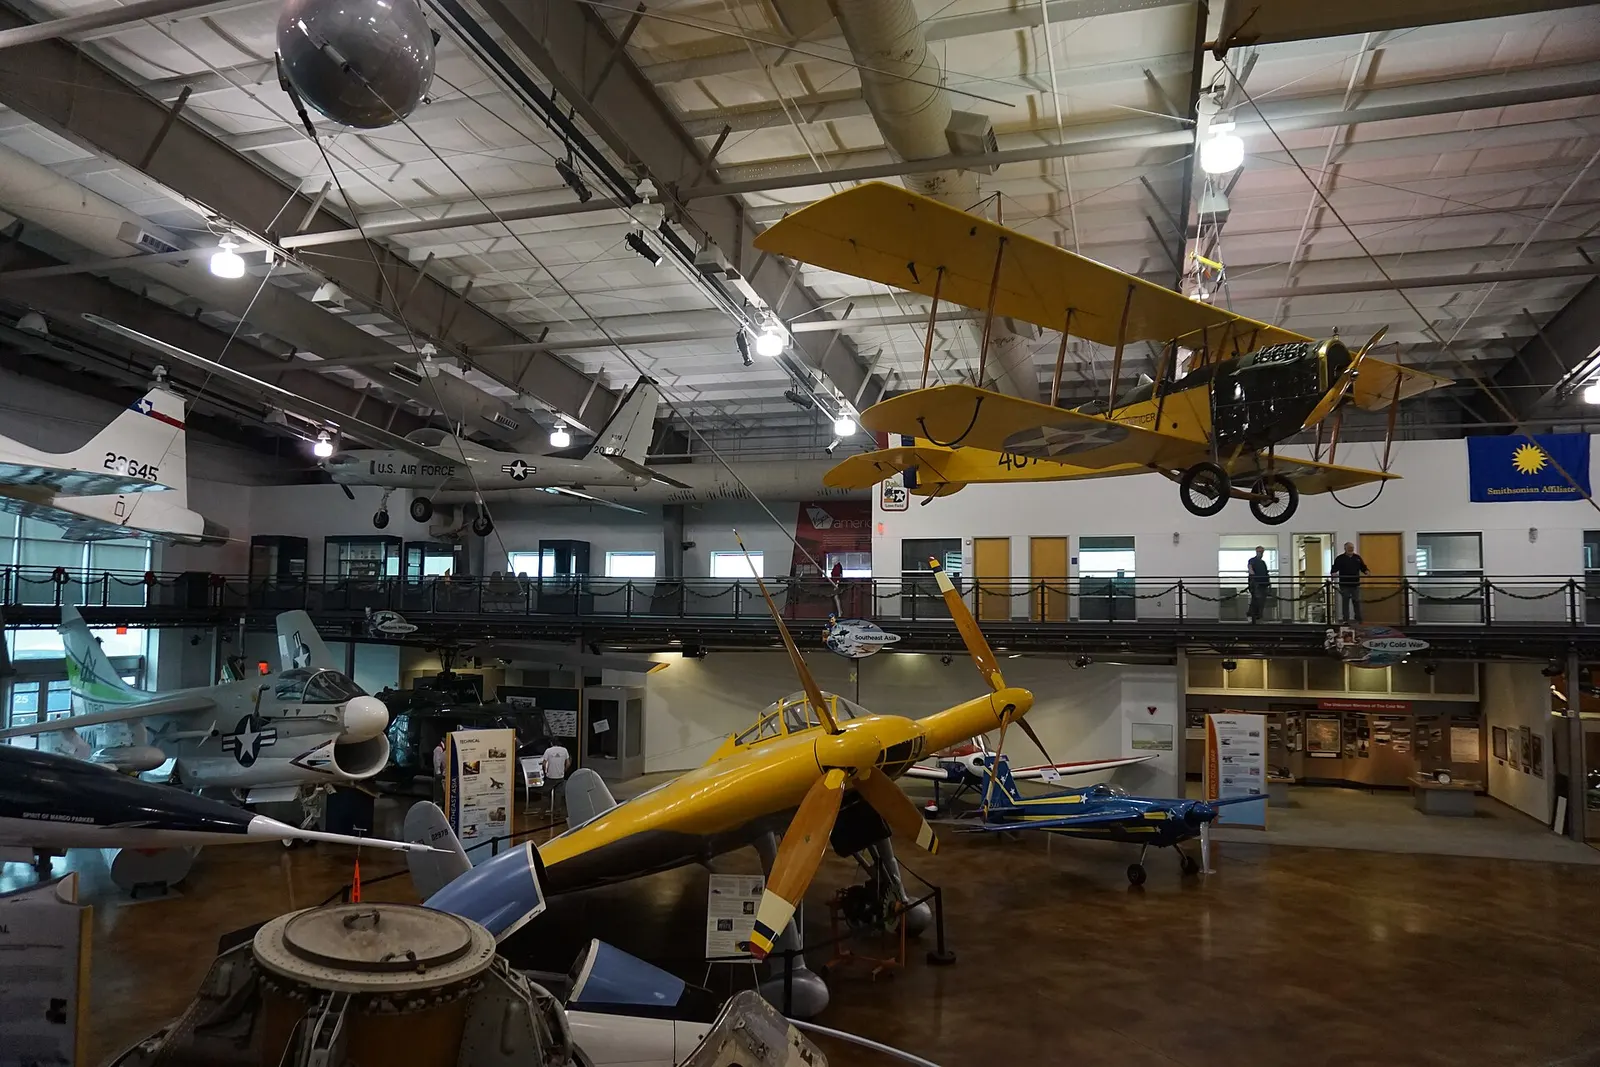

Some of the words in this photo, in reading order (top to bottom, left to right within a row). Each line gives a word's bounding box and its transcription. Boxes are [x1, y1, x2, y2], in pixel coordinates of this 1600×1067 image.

[378, 463, 396, 474] U.S.
[400, 464, 417, 475] AIR
[421, 465, 455, 476] FORCE
[1487, 486, 1540, 495] Smithsonian
[1541, 485, 1577, 493] Affiliate
[833, 518, 872, 529] americ
[15, 694, 29, 704] 25
[449, 795, 457, 831] OUTHEAST
